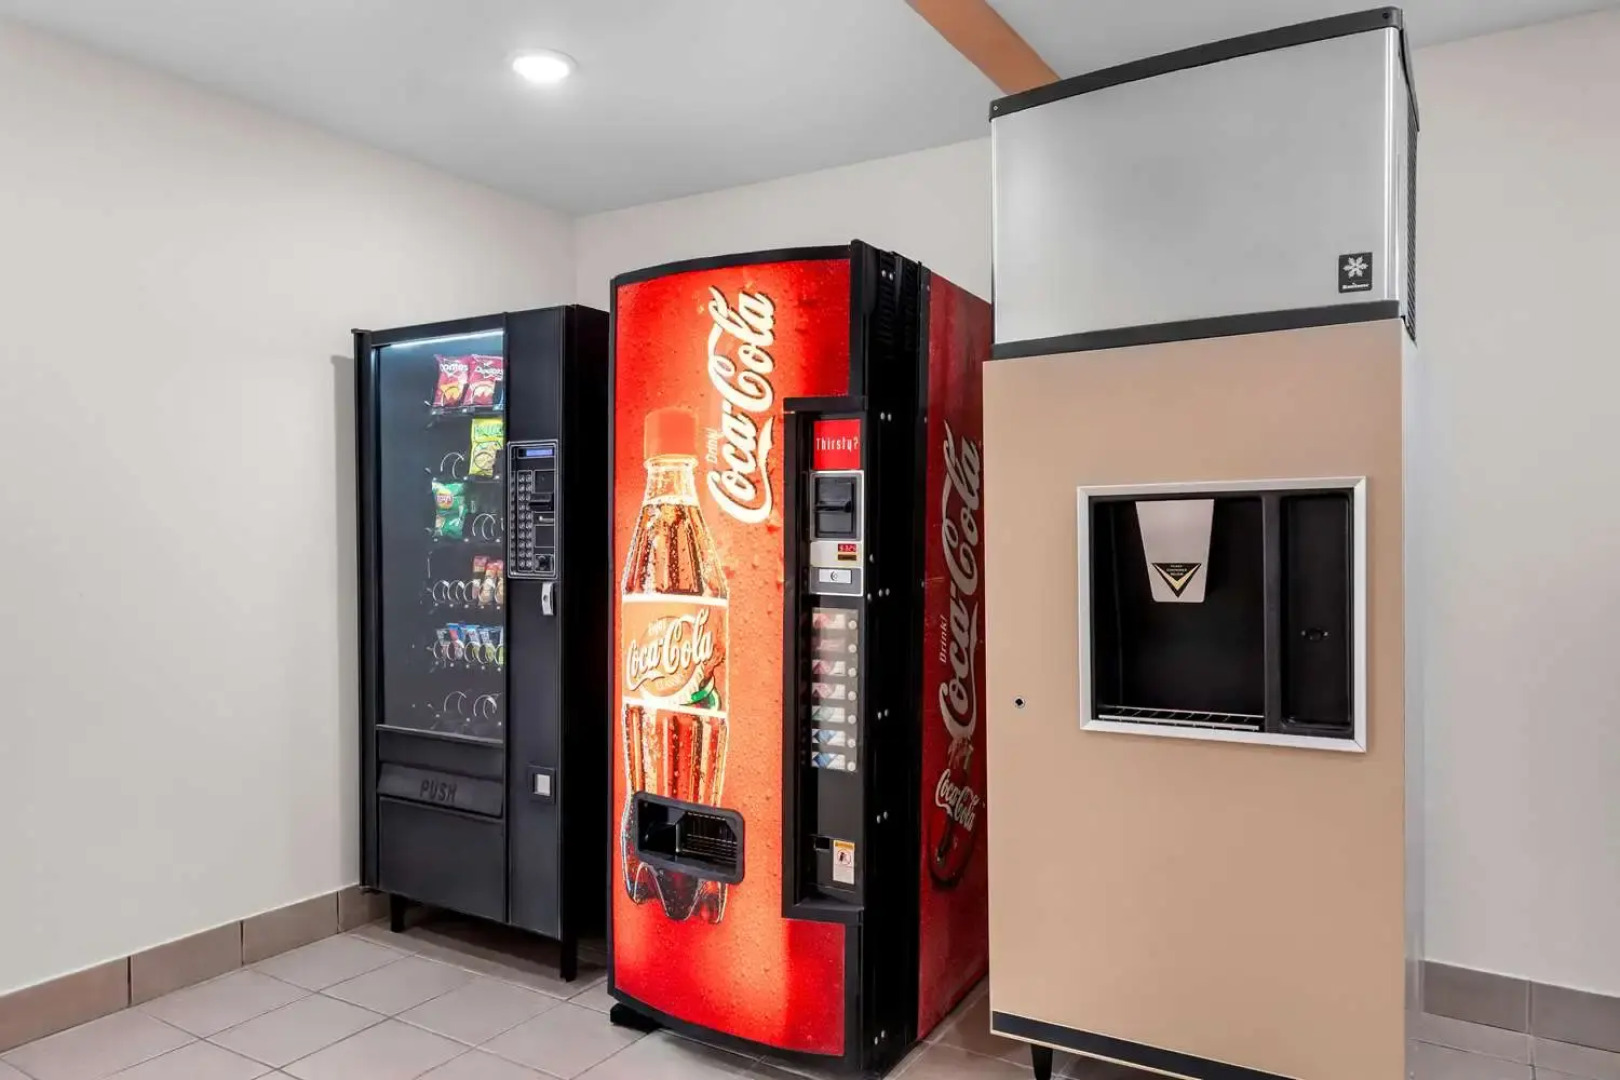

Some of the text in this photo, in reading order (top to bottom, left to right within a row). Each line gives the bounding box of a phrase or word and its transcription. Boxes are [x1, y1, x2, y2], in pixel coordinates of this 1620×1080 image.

[707, 285, 776, 523] Coca-Cola
[816, 436, 859, 453] Thirsty?
[939, 419, 980, 739] Coca-Cola
[420, 779, 458, 803] PUSH
